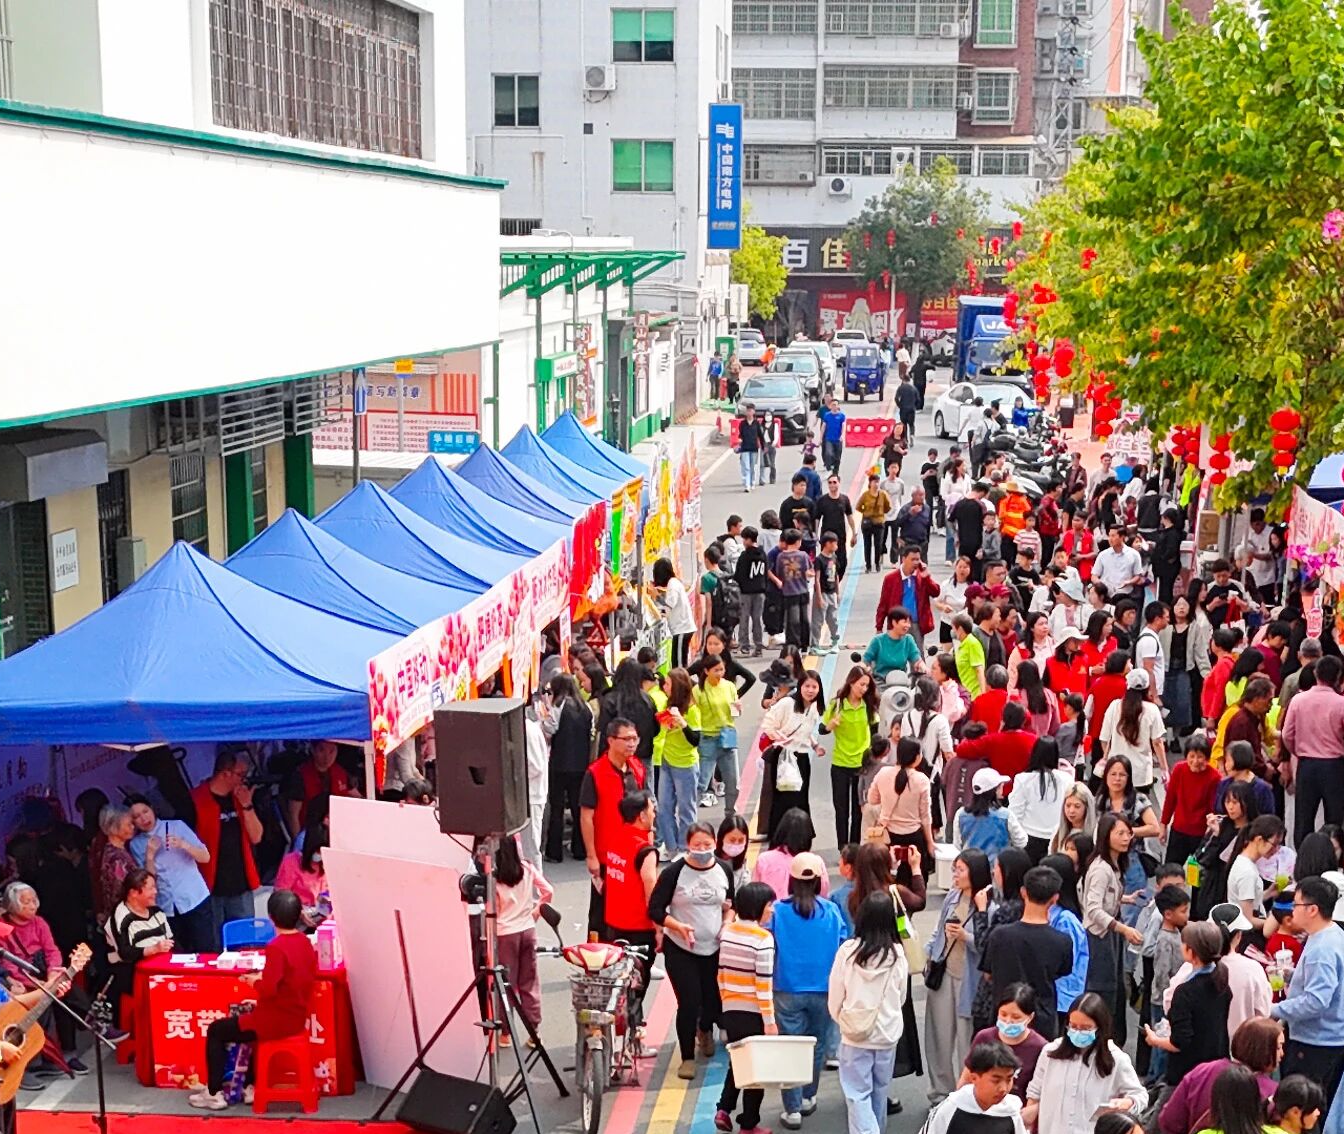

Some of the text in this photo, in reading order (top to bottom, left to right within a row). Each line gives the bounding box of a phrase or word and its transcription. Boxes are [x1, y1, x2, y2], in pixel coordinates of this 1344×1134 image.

[721, 143, 733, 209] 中国南方电网
